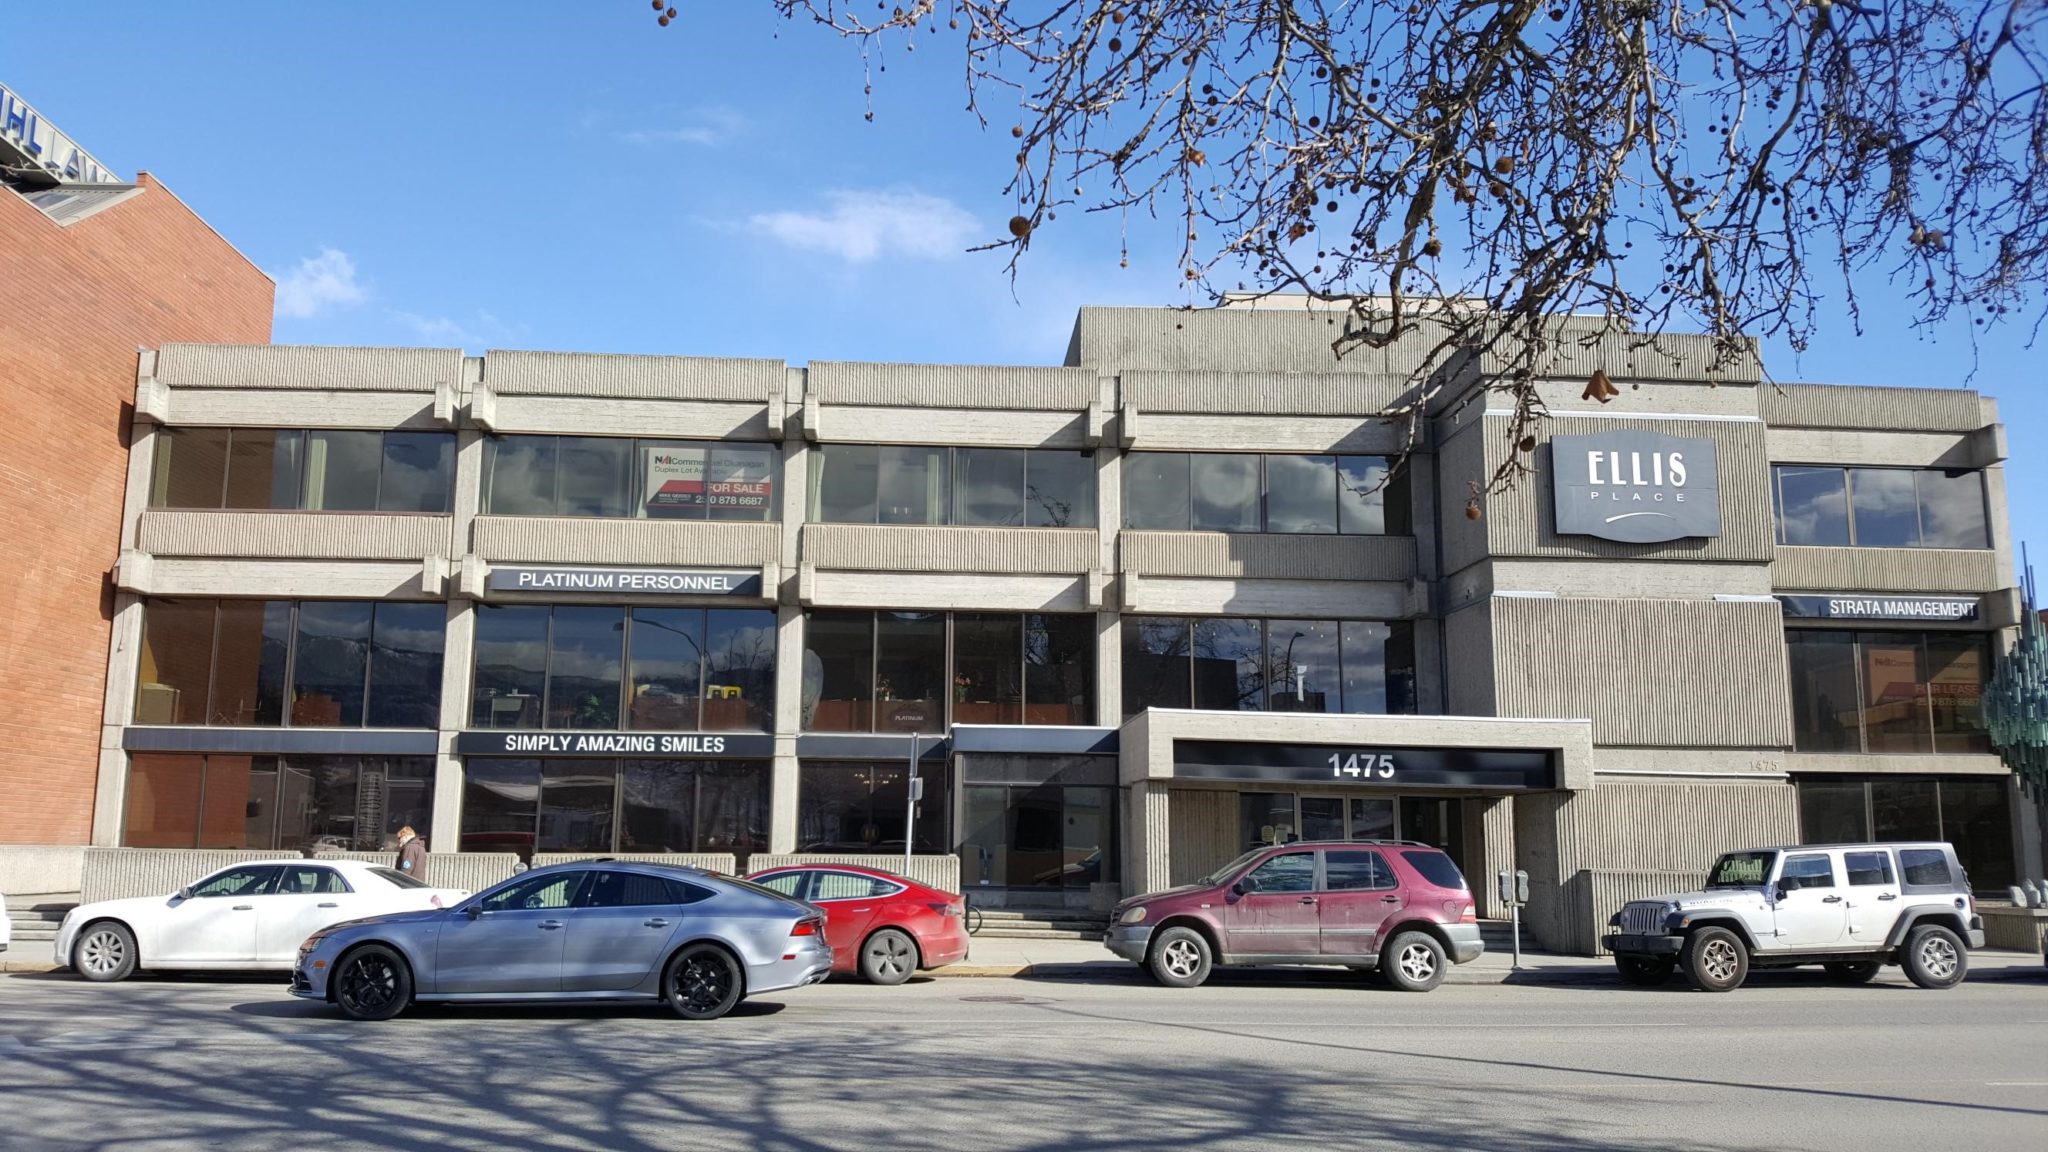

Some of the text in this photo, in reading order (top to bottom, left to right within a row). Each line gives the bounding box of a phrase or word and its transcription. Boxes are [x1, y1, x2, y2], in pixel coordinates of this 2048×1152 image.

[654, 466, 679, 474] Duplex
[1588, 450, 1687, 487] ELLIS
[734, 483, 764, 494] SALE
[718, 495, 737, 505] 878
[739, 496, 763, 506] 6687
[1590, 491, 1686, 502] PLACE
[519, 572, 734, 591] PLATINUM PERSONNEL
[1830, 599, 1976, 617] STRATA MANAGEMENT
[1943, 684, 1979, 695] LEASE
[505, 734, 725, 753] SIMPLY AMAZING SMILES
[1328, 753, 1395, 779] 1475
